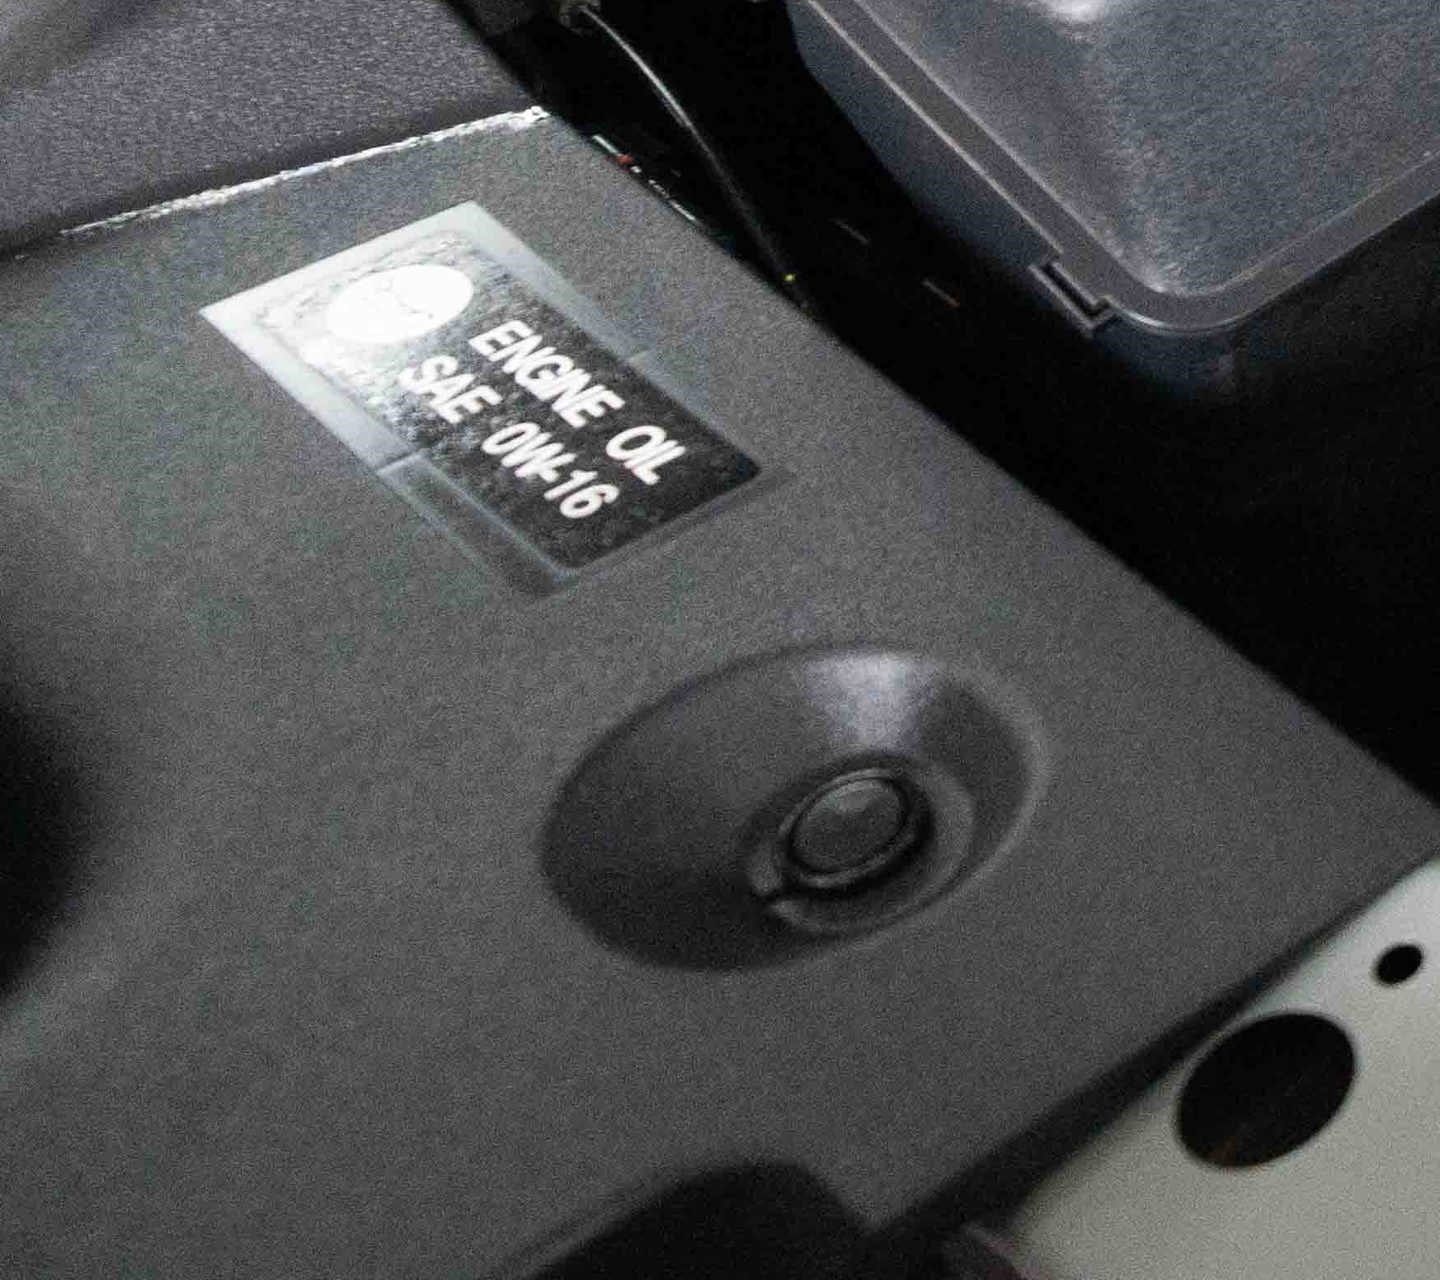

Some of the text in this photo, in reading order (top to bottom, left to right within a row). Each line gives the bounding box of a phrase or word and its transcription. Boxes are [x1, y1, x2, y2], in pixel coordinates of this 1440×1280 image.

[400, 354, 620, 519] SAE 0W-16
[468, 319, 687, 485] ENGINE OIL
